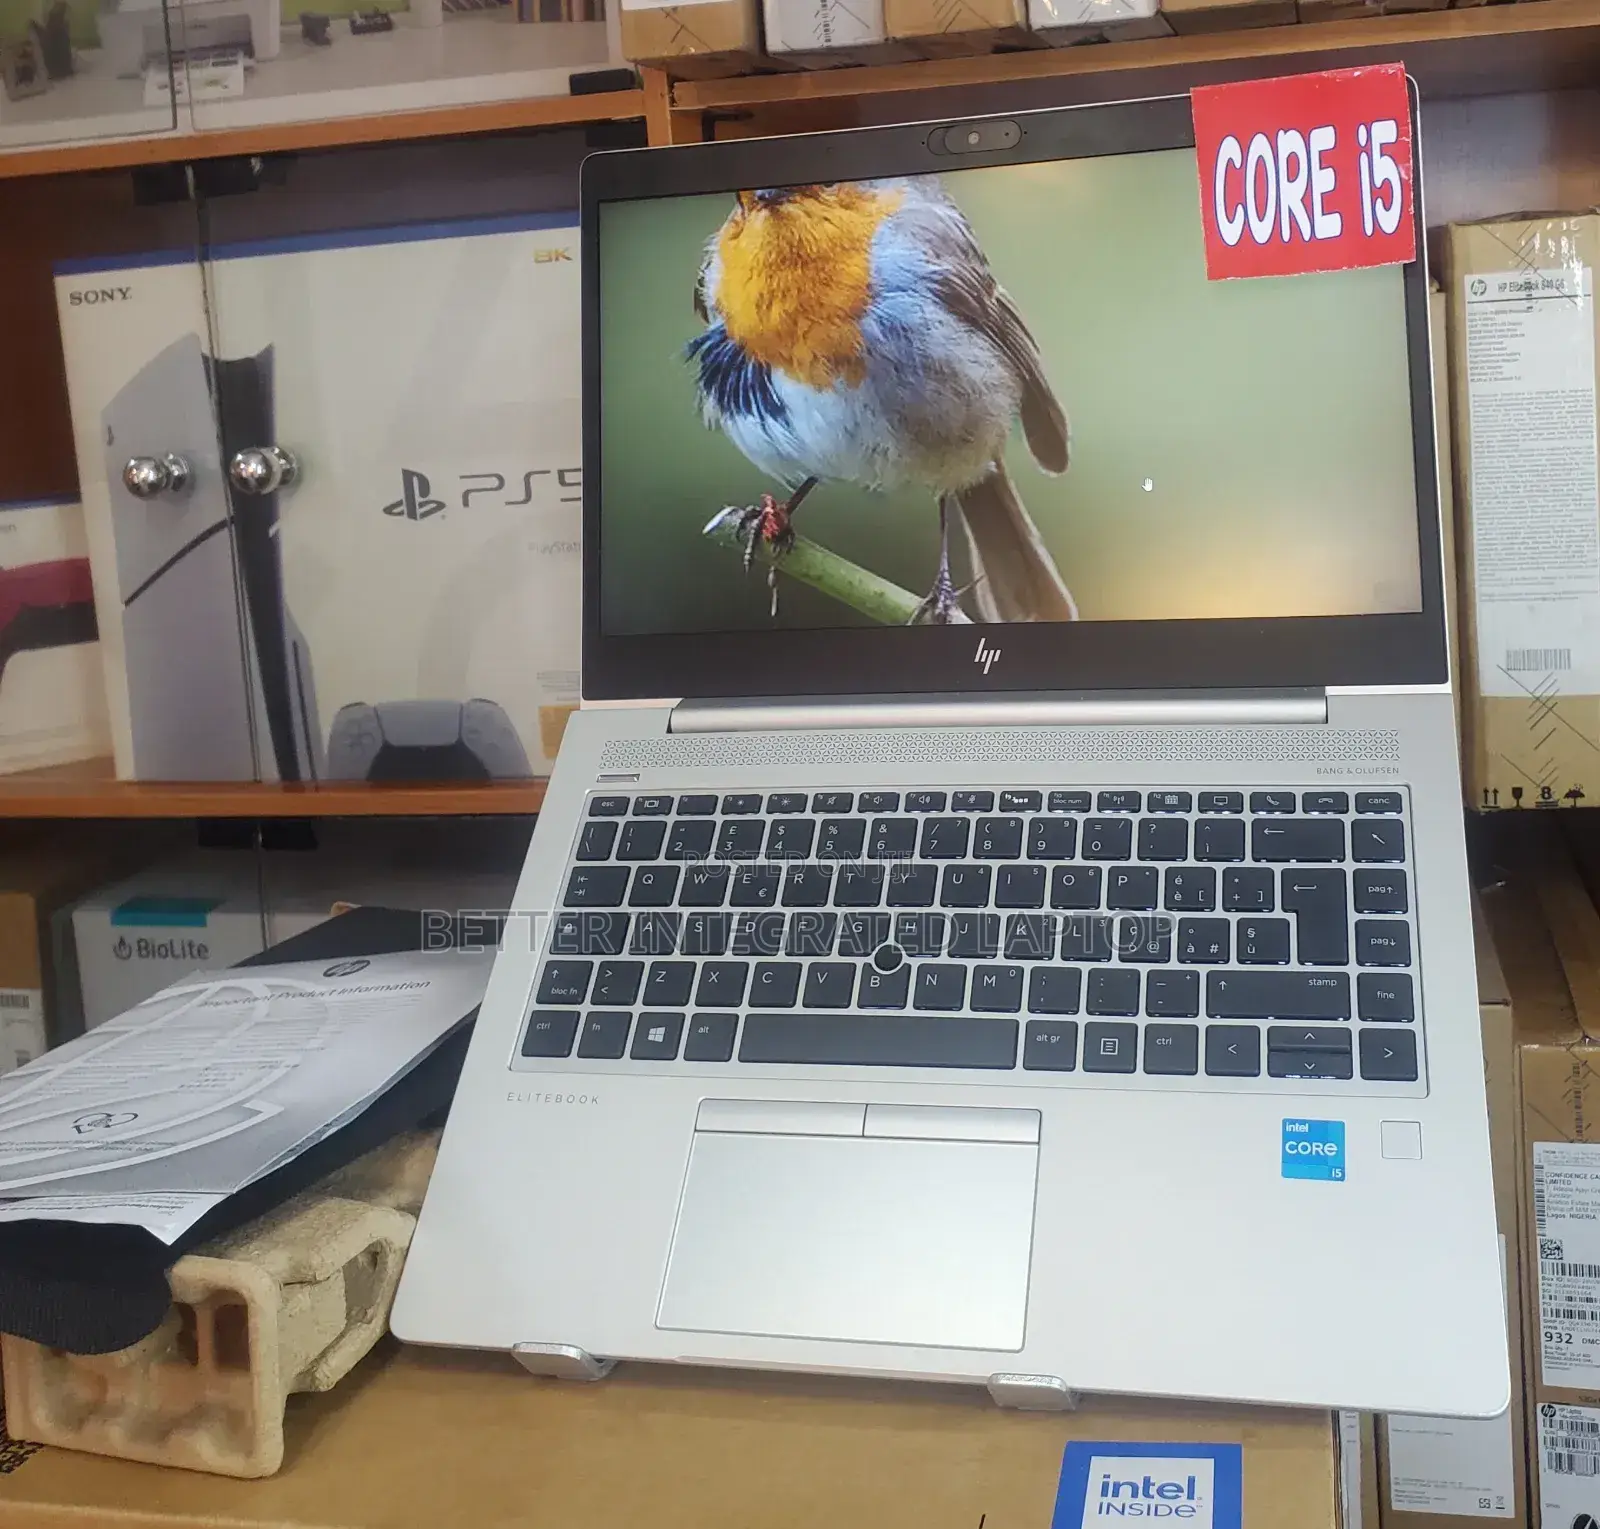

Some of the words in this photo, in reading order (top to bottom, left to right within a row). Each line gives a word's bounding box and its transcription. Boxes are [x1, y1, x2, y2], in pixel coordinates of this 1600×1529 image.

[1214, 125, 1343, 246] CORE
[1356, 118, 1403, 237] i5
[533, 247, 573, 263] 8K
[69, 287, 131, 306] SONY
[459, 468, 581, 508] PS5
[1316, 767, 1343, 775] BANG
[777, 825, 786, 836] $
[828, 825, 838, 835] %
[879, 824, 888, 833] &
[674, 842, 683, 851] 2
[724, 841, 733, 851] 3
[775, 841, 783, 850] 4
[826, 841, 834, 850] 5
[877, 840, 886, 850] 6
[930, 840, 938, 850] 7
[983, 840, 992, 850] 8
[1037, 841, 1046, 850] 9
[1092, 841, 1101, 851] 0
[642, 873, 654, 885] Q
[693, 874, 709, 884] W
[742, 874, 751, 884] E
[794, 874, 804, 884] R
[846, 874, 856, 884] T
[899, 874, 910, 884] Y
[953, 873, 963, 884] U
[1063, 874, 1075, 885] O
[1118, 876, 1128, 886] P
[1368, 885, 1386, 894] pag
[643, 922, 653, 932] A
[694, 922, 703, 932] S
[745, 922, 756, 932] D
[798, 922, 808, 932] F
[852, 922, 863, 932] G
[905, 922, 916, 932] H
[960, 923, 968, 934] J
[1016, 925, 1027, 935] K
[1073, 926, 1081, 937] L
[1371, 937, 1389, 946] pag
[137, 938, 210, 959] BioLite
[1147, 941, 1160, 953] @
[656, 971, 666, 982] Z
[708, 972, 719, 983] X
[762, 972, 774, 983] C
[817, 972, 829, 984] V
[870, 976, 880, 987] B
[926, 974, 938, 985] N
[983, 975, 996, 987] M
[1308, 978, 1337, 987] stamp
[338, 979, 432, 997] Information
[551, 986, 568, 995] bloc
[569, 986, 578, 995] fn
[1377, 990, 1395, 999] fine
[536, 1022, 551, 1030] ctrl
[592, 1023, 600, 1031] fn
[698, 1025, 709, 1034] alt
[1036, 1034, 1048, 1042] alt
[1050, 1035, 1060, 1044] gr
[1156, 1037, 1172, 1045] ctrl
[507, 1092, 600, 1105] ELITEBOOK
[1286, 1123, 1309, 1133] intel
[1332, 1169, 1342, 1178] i5
[1545, 1171, 1588, 1180] CONFIDENCE
[1544, 1331, 1573, 1345] 932
[1541, 1404, 1556, 1418] hp
[1100, 1474, 1196, 1501] intel
